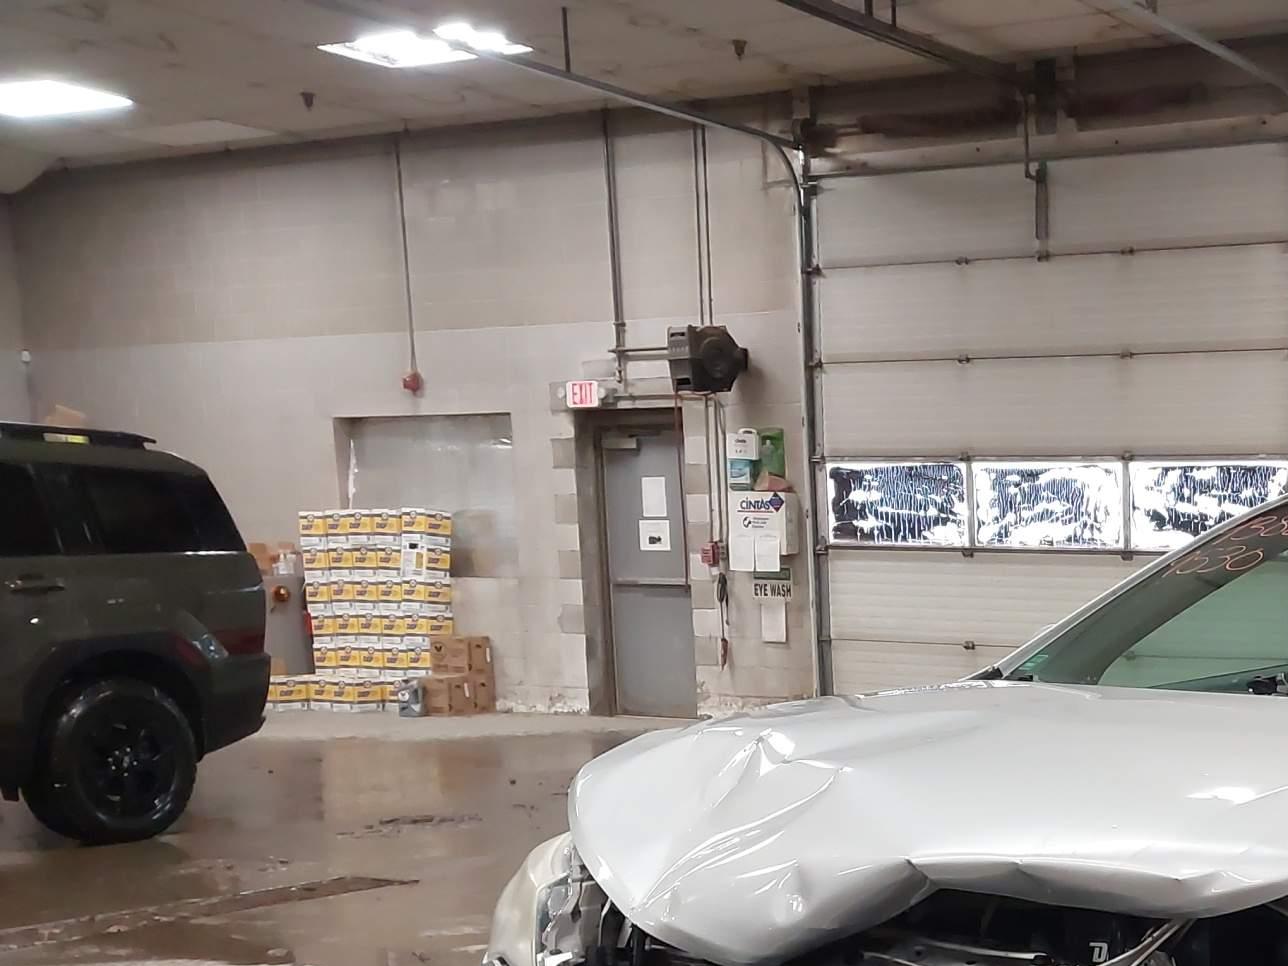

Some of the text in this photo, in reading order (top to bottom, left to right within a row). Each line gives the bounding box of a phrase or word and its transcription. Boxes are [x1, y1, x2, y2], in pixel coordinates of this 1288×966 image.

[571, 383, 593, 405] EXIT
[740, 496, 770, 510] CINTAS
[754, 583, 792, 598] EYE WASH
